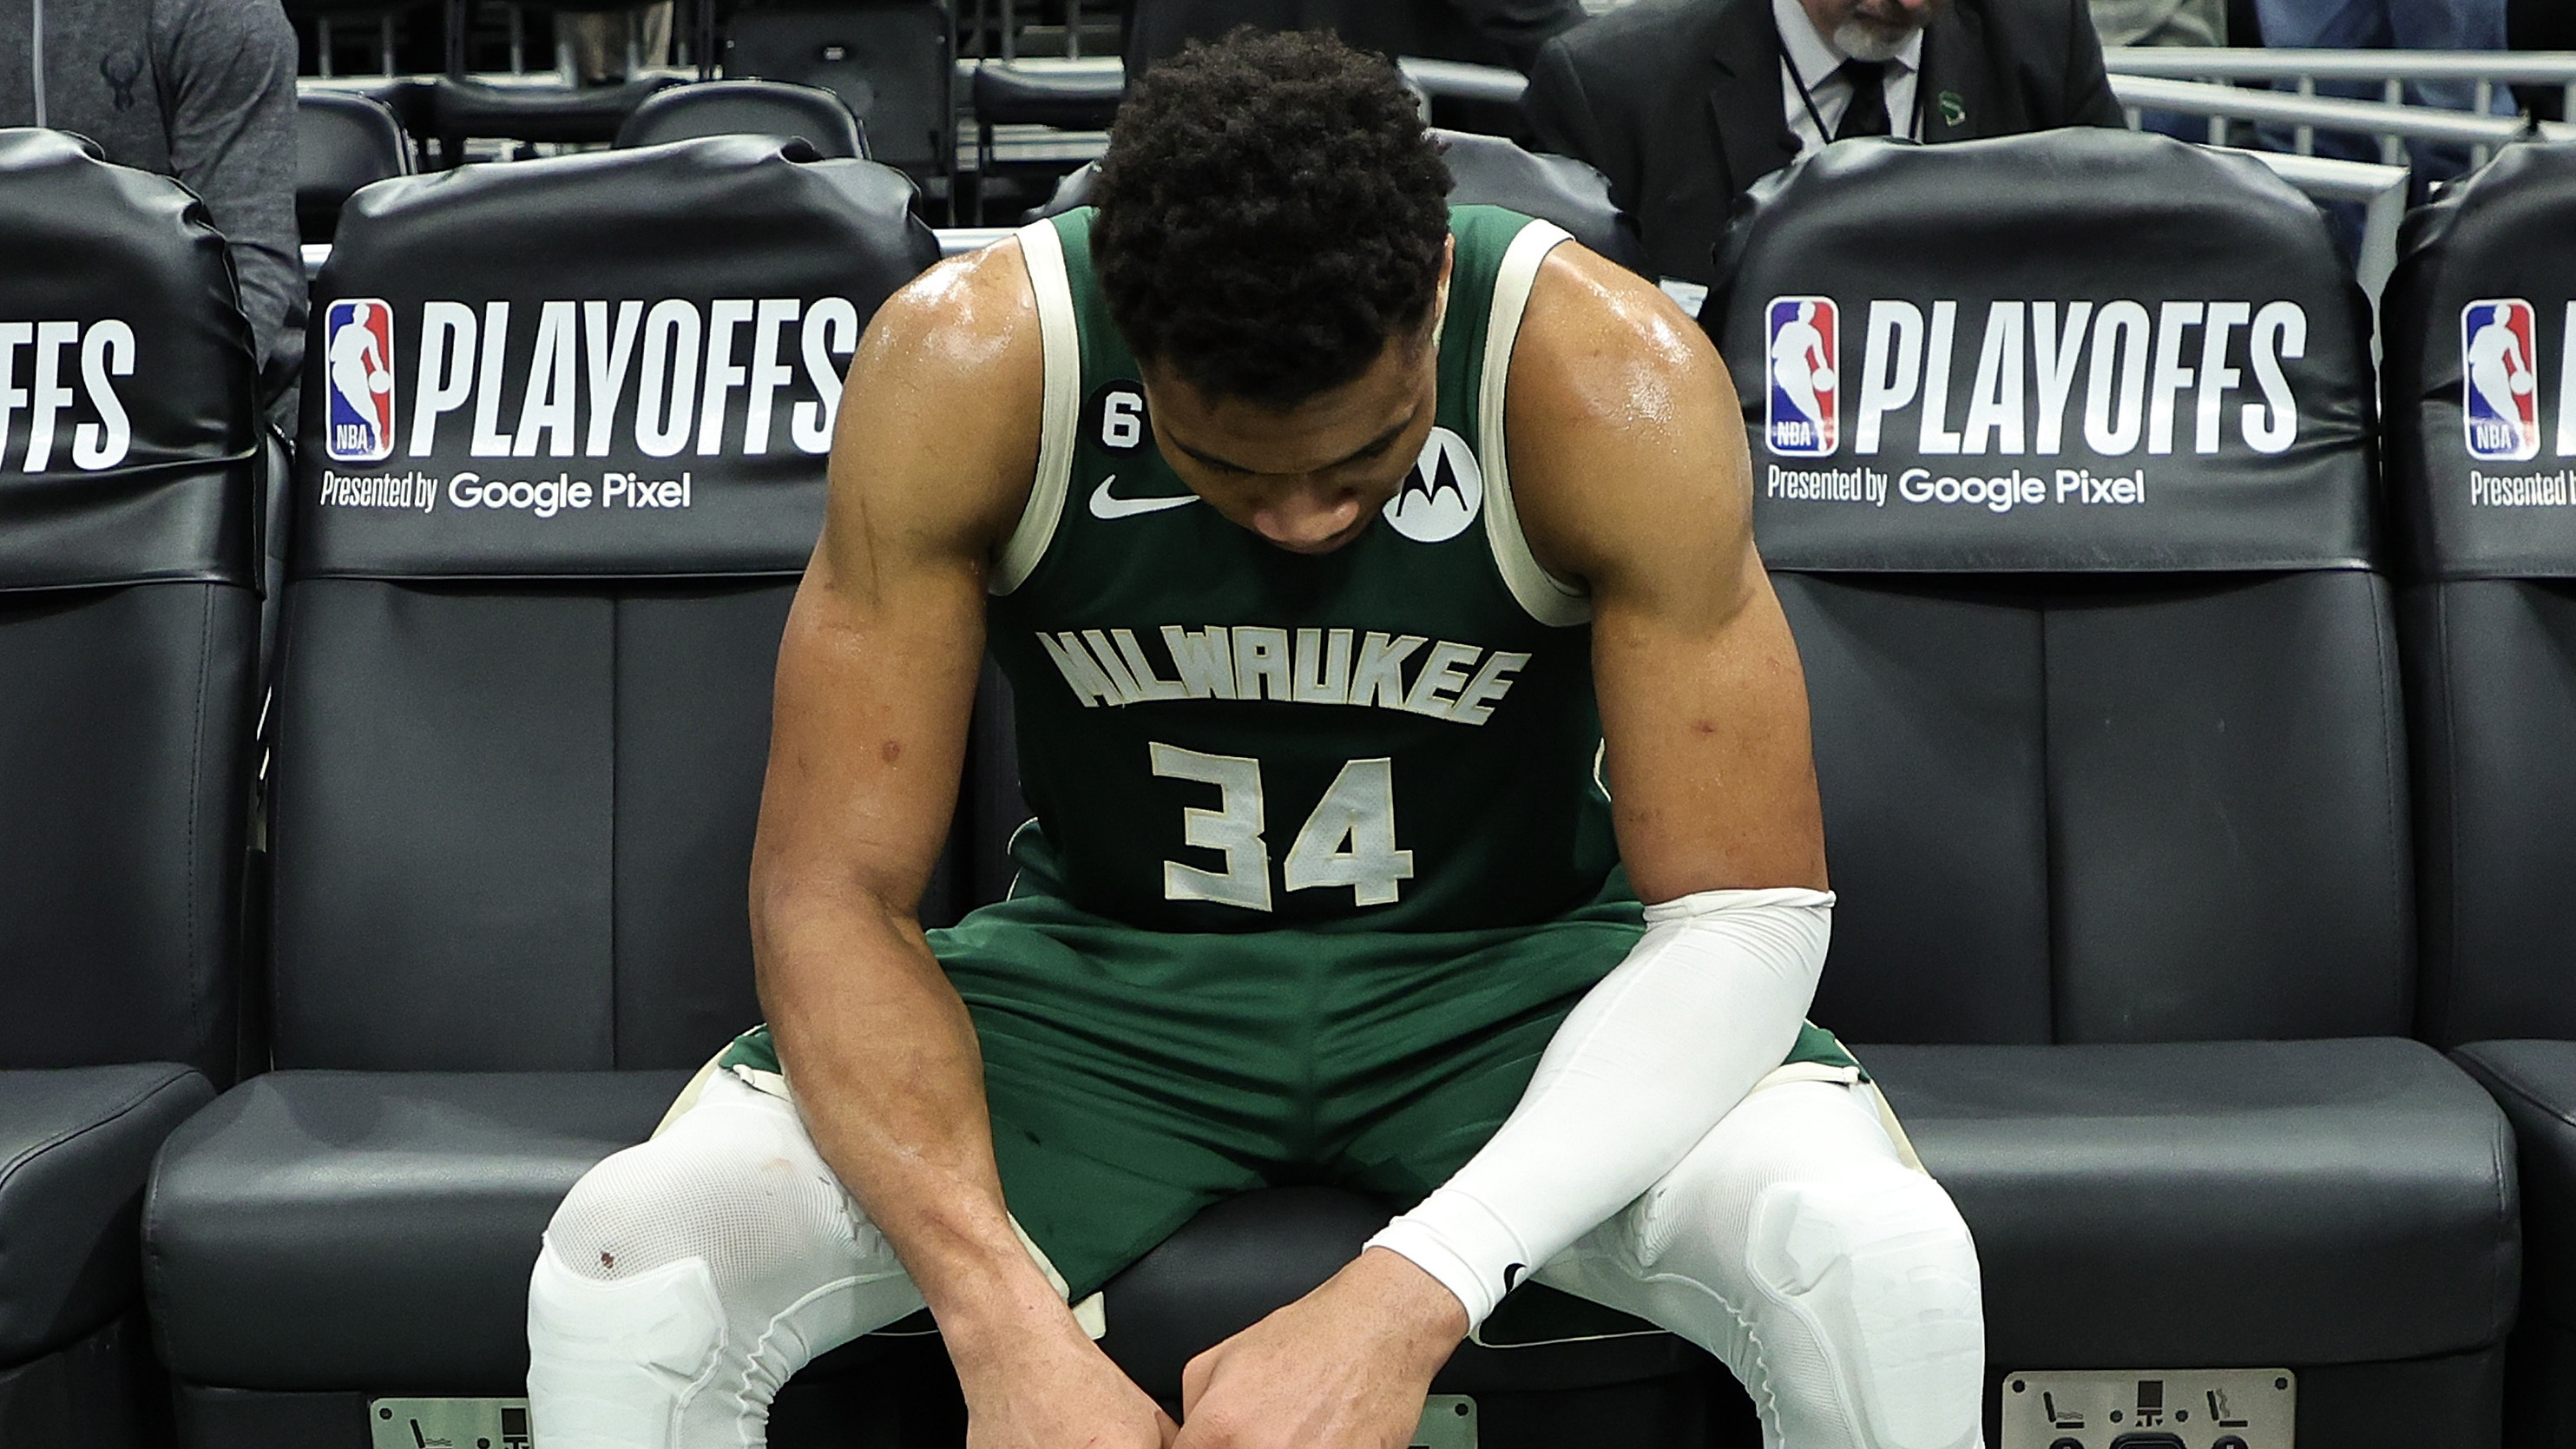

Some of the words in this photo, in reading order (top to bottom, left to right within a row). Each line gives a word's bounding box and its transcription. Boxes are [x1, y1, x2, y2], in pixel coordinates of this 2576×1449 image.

[409, 297, 858, 457] PLAYOFFS
[1855, 300, 2307, 455] PLAYOFFS
[336, 425, 369, 450] NBA
[1102, 392, 1142, 448] 6
[1778, 421, 1811, 447] NBA
[2476, 425, 2512, 450] NBA
[320, 471, 412, 507] Presented
[414, 471, 437, 513] by
[448, 472, 592, 517] Google
[603, 472, 691, 509] Pixel
[1768, 464, 1862, 501] Presented
[1865, 467, 1888, 507] by
[1898, 469, 2046, 511] Google
[2057, 470, 2146, 504] Pixel
[2470, 470, 2566, 506] Presented
[1035, 625, 1533, 726] MILWAUKEE
[1148, 741, 1415, 912] 34
